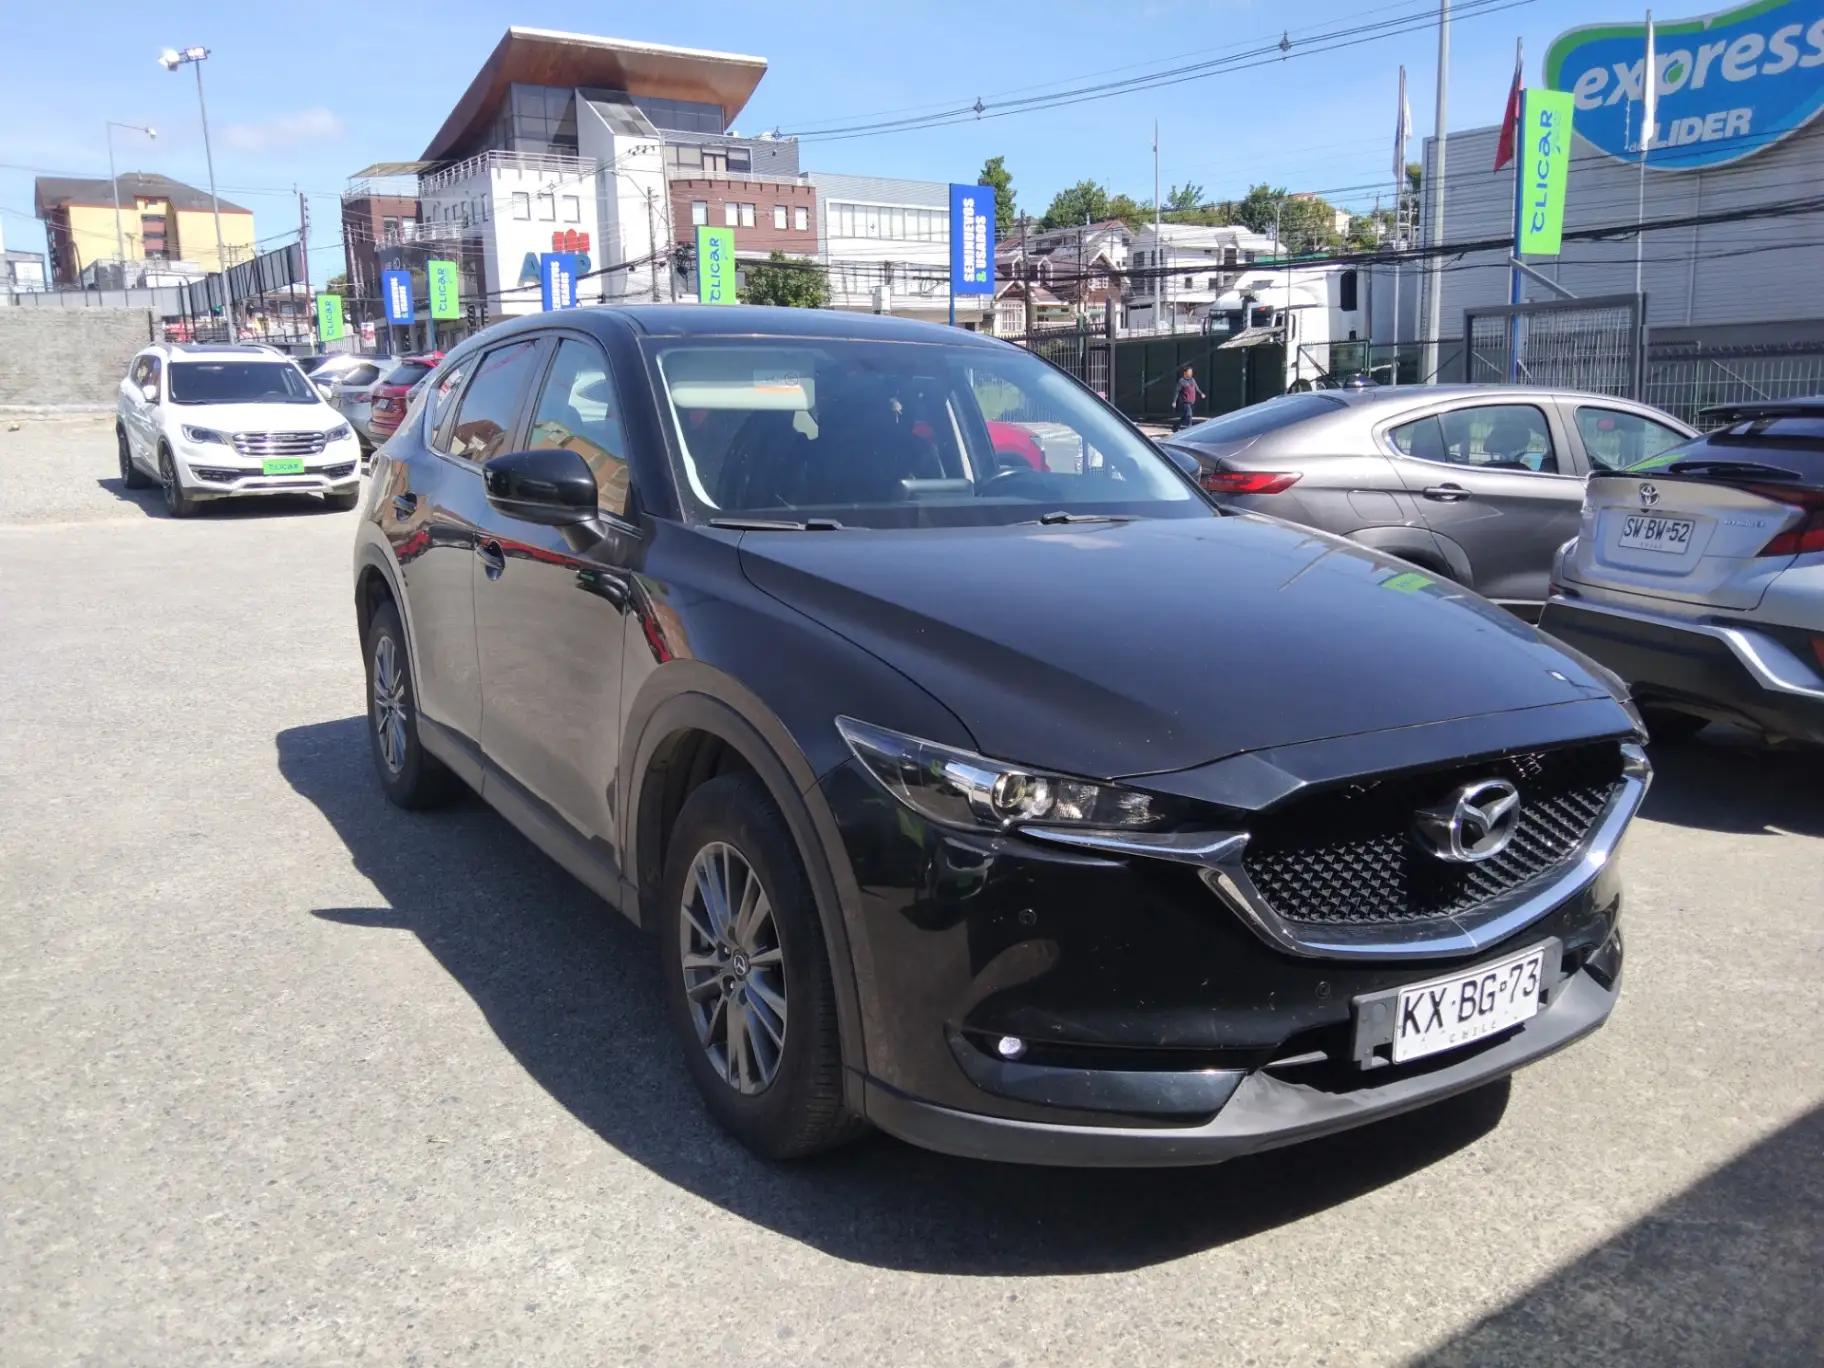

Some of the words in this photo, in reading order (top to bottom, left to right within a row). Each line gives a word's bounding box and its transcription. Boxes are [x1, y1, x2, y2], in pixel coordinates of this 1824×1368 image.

[1653, 108, 1752, 149] LIDER
[963, 198, 975, 282] SEMINUEVOS
[976, 215, 987, 269] USADOS
[976, 271, 987, 282] &
